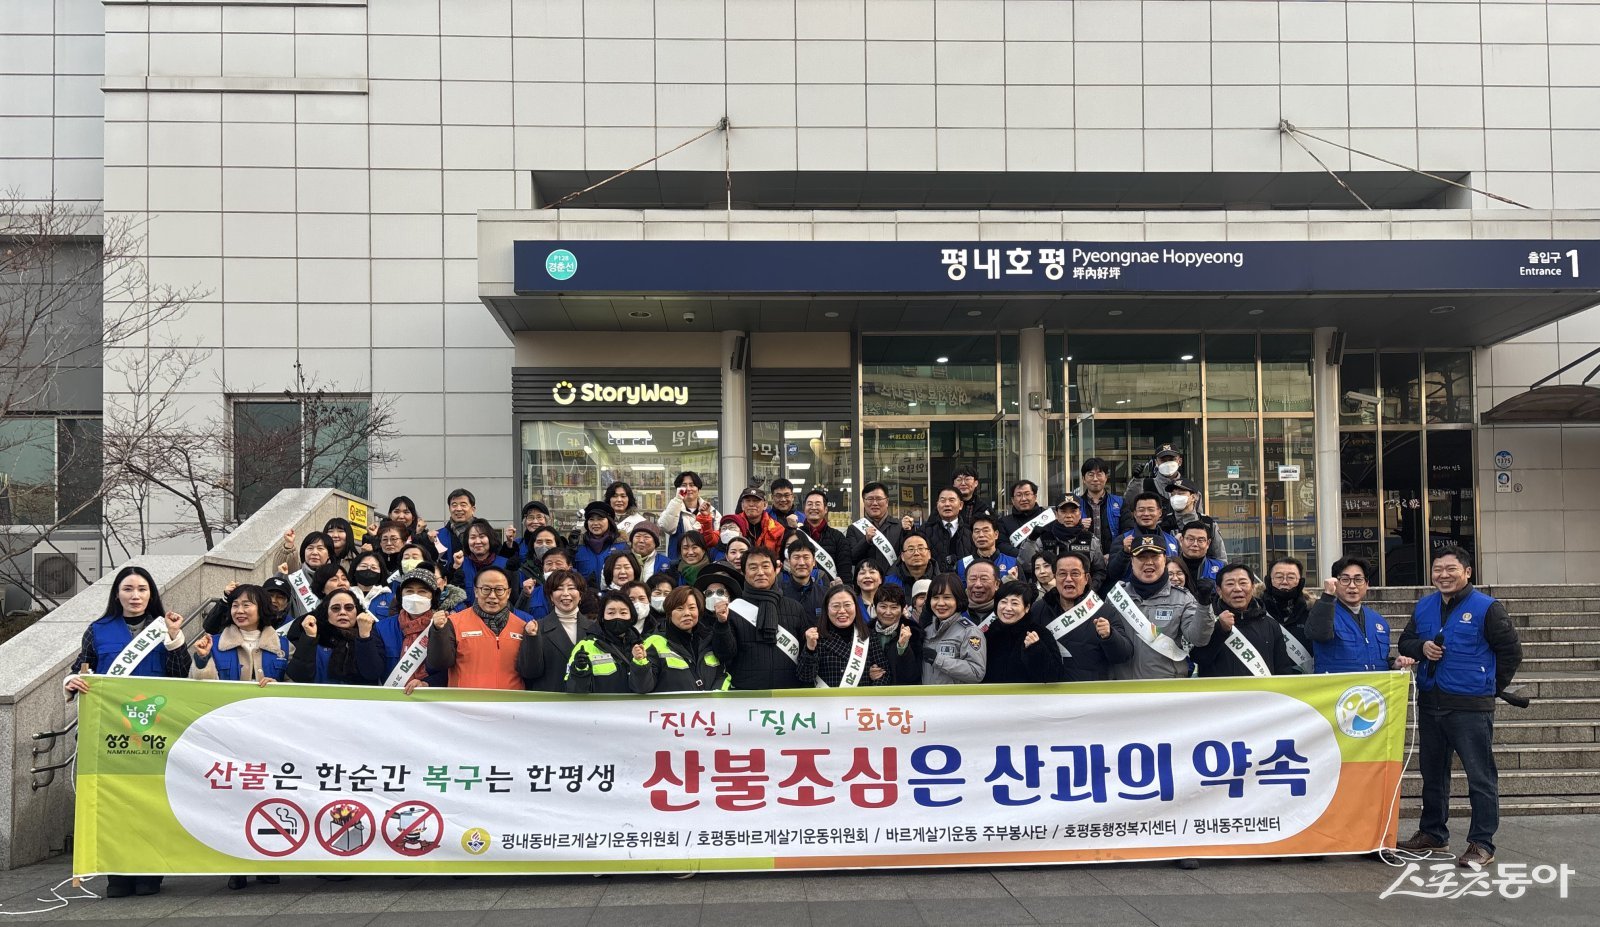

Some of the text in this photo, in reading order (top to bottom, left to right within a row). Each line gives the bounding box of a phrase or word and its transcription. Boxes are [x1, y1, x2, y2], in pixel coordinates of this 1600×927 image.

[549, 261, 574, 273] 경춘선
[941, 248, 1065, 281] 평내호평
[1072, 248, 1244, 267] Pyeongnae Hopyeong
[1528, 249, 1579, 278] 출입구 1
[1519, 266, 1562, 276] Entrance
[580, 383, 689, 405] StoryWay
[126, 703, 157, 725] 남양주
[204, 761, 615, 793] 산불은 한순간 복구는 한평생
[642, 739, 1311, 812] 산불조심은 산과의 약속
[501, 830, 679, 850] 평내동바르게살기운동위원회
[697, 827, 868, 847] 호평동바르게살기운동위원회
[886, 826, 978, 843] 바르게살기운동
[982, 824, 1048, 842] 주부봉사단
[1063, 820, 1177, 839] 호평동행정복지센터
[1193, 816, 1281, 835] 평내동주민센터
